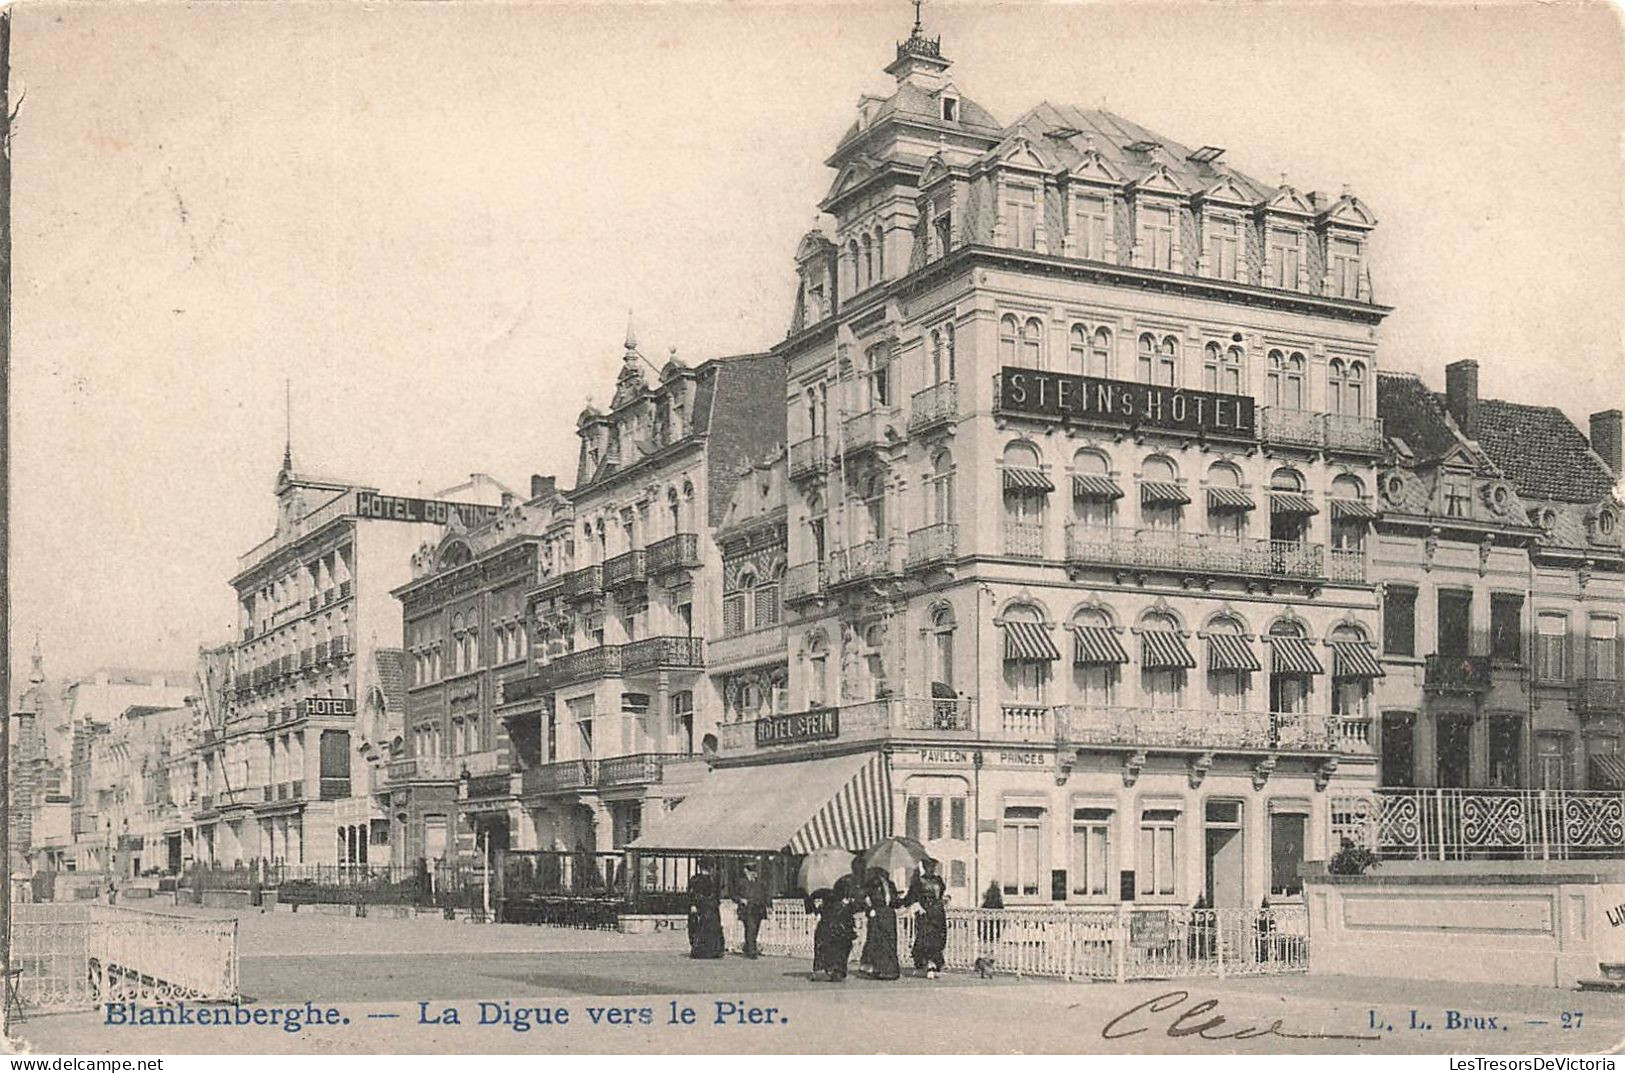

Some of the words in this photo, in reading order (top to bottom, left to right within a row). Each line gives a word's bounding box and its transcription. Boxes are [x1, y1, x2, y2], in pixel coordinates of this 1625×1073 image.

[306, 700, 351, 714] HOTEL
[798, 713, 832, 735] STEIN
[921, 750, 967, 762] PAVILLON
[1000, 753, 1045, 765] PRINCES
